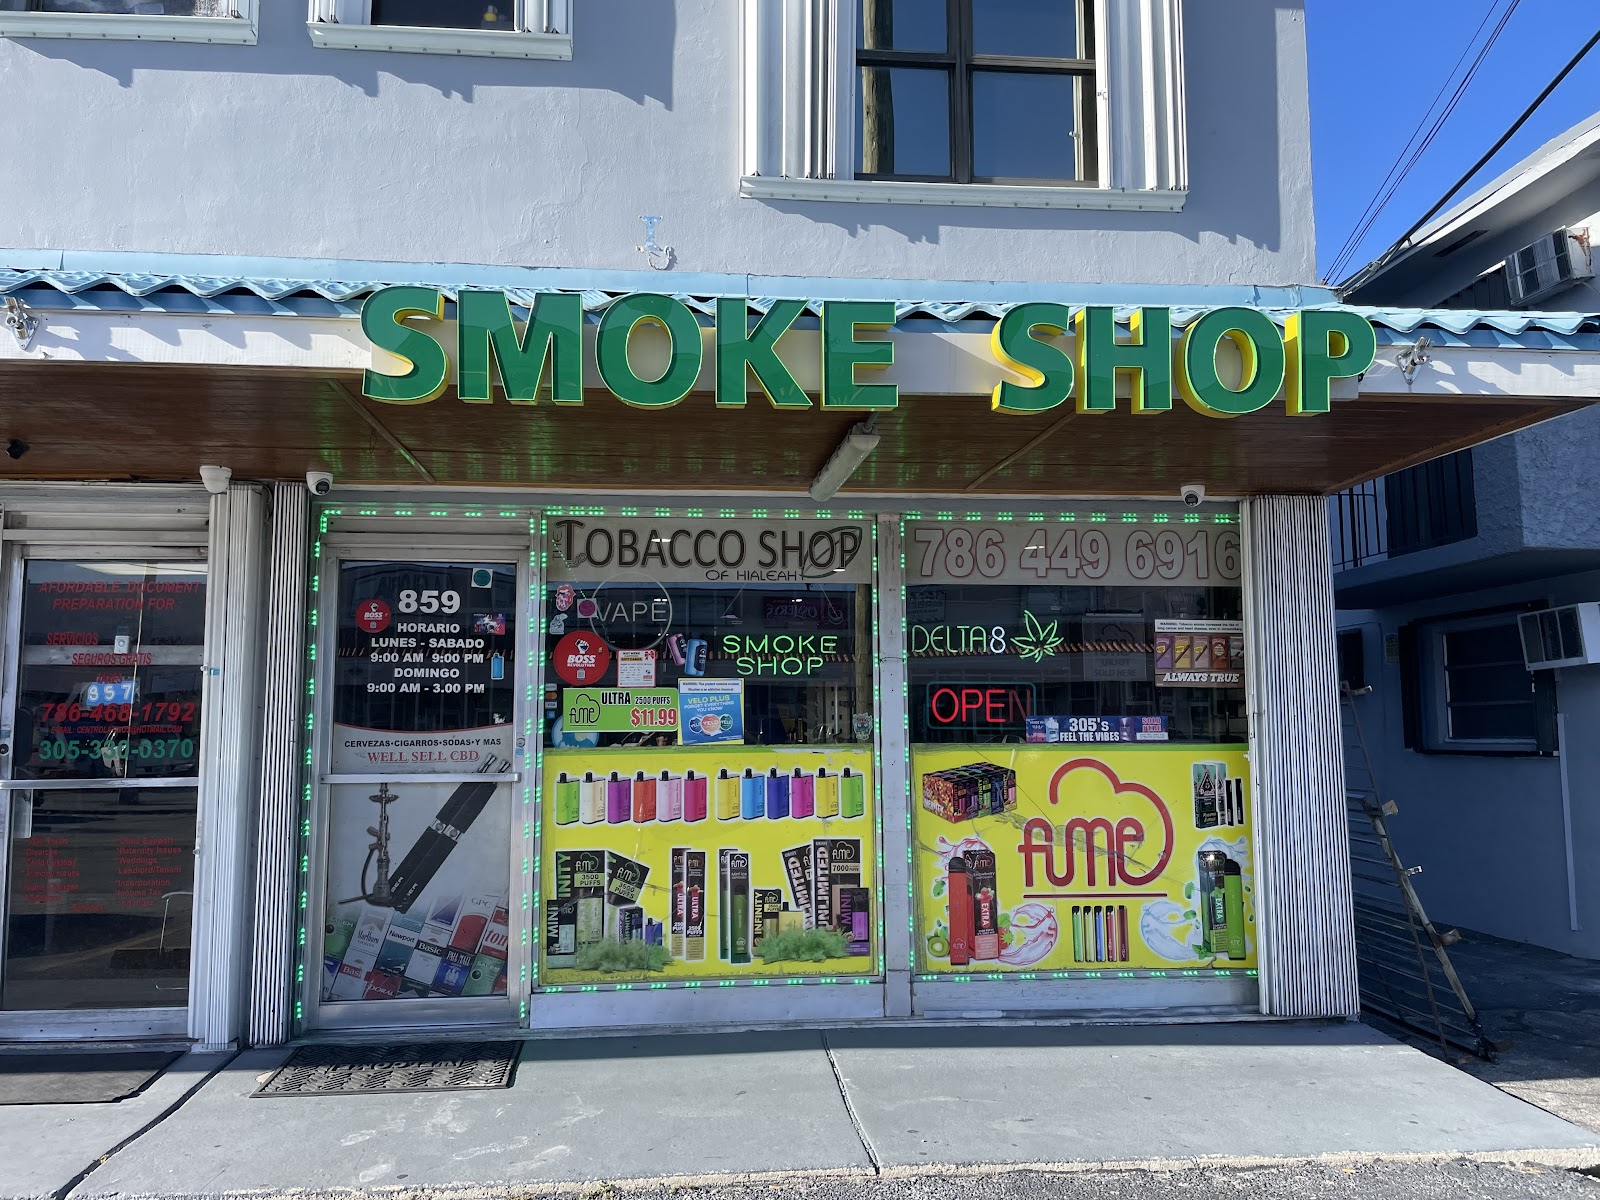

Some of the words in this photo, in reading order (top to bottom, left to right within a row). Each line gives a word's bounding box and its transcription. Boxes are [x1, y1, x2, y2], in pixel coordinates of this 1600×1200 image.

[361, 285, 899, 411] SMOKE
[991, 301, 1376, 418] SHOP
[556, 519, 747, 568] TOBACCO
[758, 528, 858, 570] SHOP
[915, 527, 1005, 578] 786
[1019, 528, 1111, 579] 449
[1126, 529, 1241, 580] 6916
[705, 569, 729, 582] OF
[736, 569, 798, 582] HIALEAH
[39, 581, 120, 594] AFORDABLE
[127, 581, 202, 594] DOCUMENT
[52, 598, 144, 611] PREPARATION
[147, 598, 176, 610] FOR
[398, 589, 461, 615] 859
[596, 602, 668, 622] VAPE
[397, 622, 460, 634] HORARIO
[46, 632, 99, 646] SERVICIOS
[371, 637, 417, 648] LUNES
[428, 638, 485, 649] SABADO
[723, 634, 838, 654] SMOKE
[71, 652, 119, 666] SEGUROS
[119, 652, 153, 665] GRATIS
[370, 652, 400, 663] 9:00
[402, 652, 424, 663] AM
[431, 653, 461, 664] 9:00
[463, 653, 485, 664] PM
[567, 654, 596, 664] BOSS
[736, 655, 824, 676] SHOP
[394, 667, 460, 679] DOMINGO
[1162, 672, 1209, 683] ALWAYS
[1209, 673, 1240, 684] TRUE
[87, 683, 133, 702] 857
[366, 682, 396, 693] 9:00
[399, 682, 421, 693] AM
[432, 683, 461, 694] 3.00
[464, 683, 485, 694] PM
[601, 691, 631, 705] ULTRA
[634, 696, 652, 705] 2500
[652, 696, 671, 705] PUFFS
[687, 696, 709, 705] VELO
[709, 694, 730, 703] PLUS
[40, 702, 196, 723] 786-468-1792
[931, 688, 1032, 724] OPEN
[630, 707, 678, 728] $11.99
[1068, 717, 1110, 732] 305's
[482, 738, 502, 746] MAS
[1060, 731, 1078, 742] FEEL
[1078, 731, 1095, 742] THE
[1095, 731, 1120, 742] VIBES
[367, 750, 409, 764] WELL
[411, 750, 448, 763] SELL
[449, 750, 480, 762] CBD
[614, 887, 635, 899] PUFFS
[618, 882, 635, 893] 3500
[471, 896, 491, 909] GPC
[676, 892, 685, 916] ULTRA
[691, 896, 699, 920] ULTRA
[841, 893, 852, 925] MINI
[1215, 897, 1224, 920] EXTRA
[547, 903, 559, 938] MINI
[755, 891, 763, 936] INFINITY
[981, 902, 990, 926] EXTRA
[388, 930, 416, 943] Newport
[418, 942, 442, 955] Basic
[477, 961, 500, 972] SALEM
[367, 983, 395, 997] DORAL
